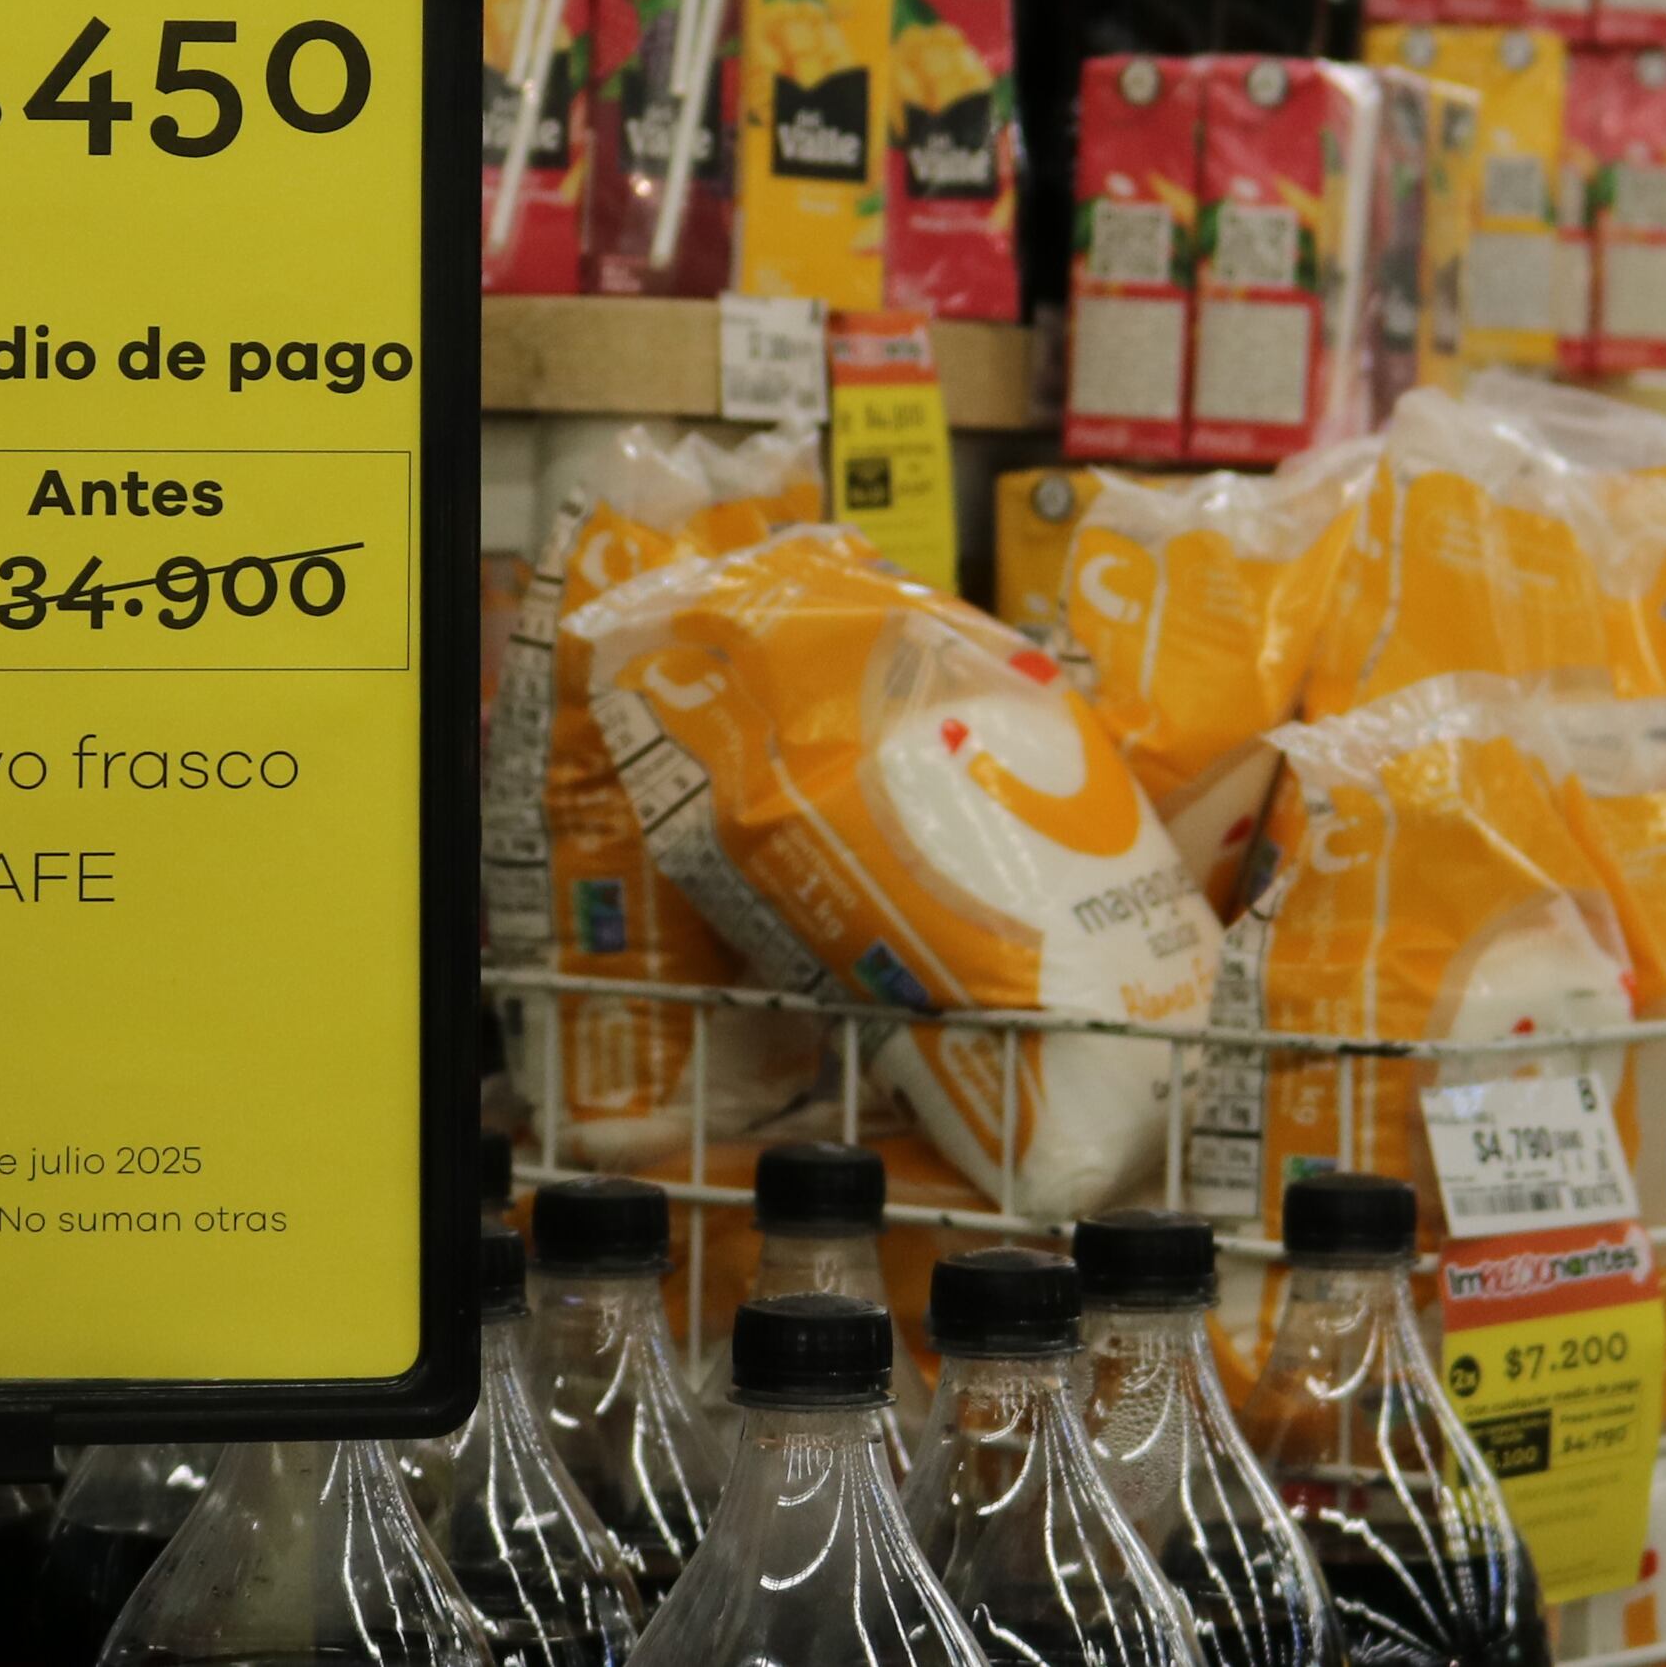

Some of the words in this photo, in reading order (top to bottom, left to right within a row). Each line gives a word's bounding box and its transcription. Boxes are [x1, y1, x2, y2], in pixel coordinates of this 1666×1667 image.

[118, 326, 206, 381] de
[229, 341, 413, 394] pago
[27, 469, 223, 517] Antes
[72, 733, 299, 790] frasco
[27, 1145, 105, 1182] julio
[116, 1146, 202, 1175] 2025
[58, 1211, 181, 1233] suman
[194, 1206, 287, 1233] otras
[1504, 1332, 1628, 1382] $7.200
